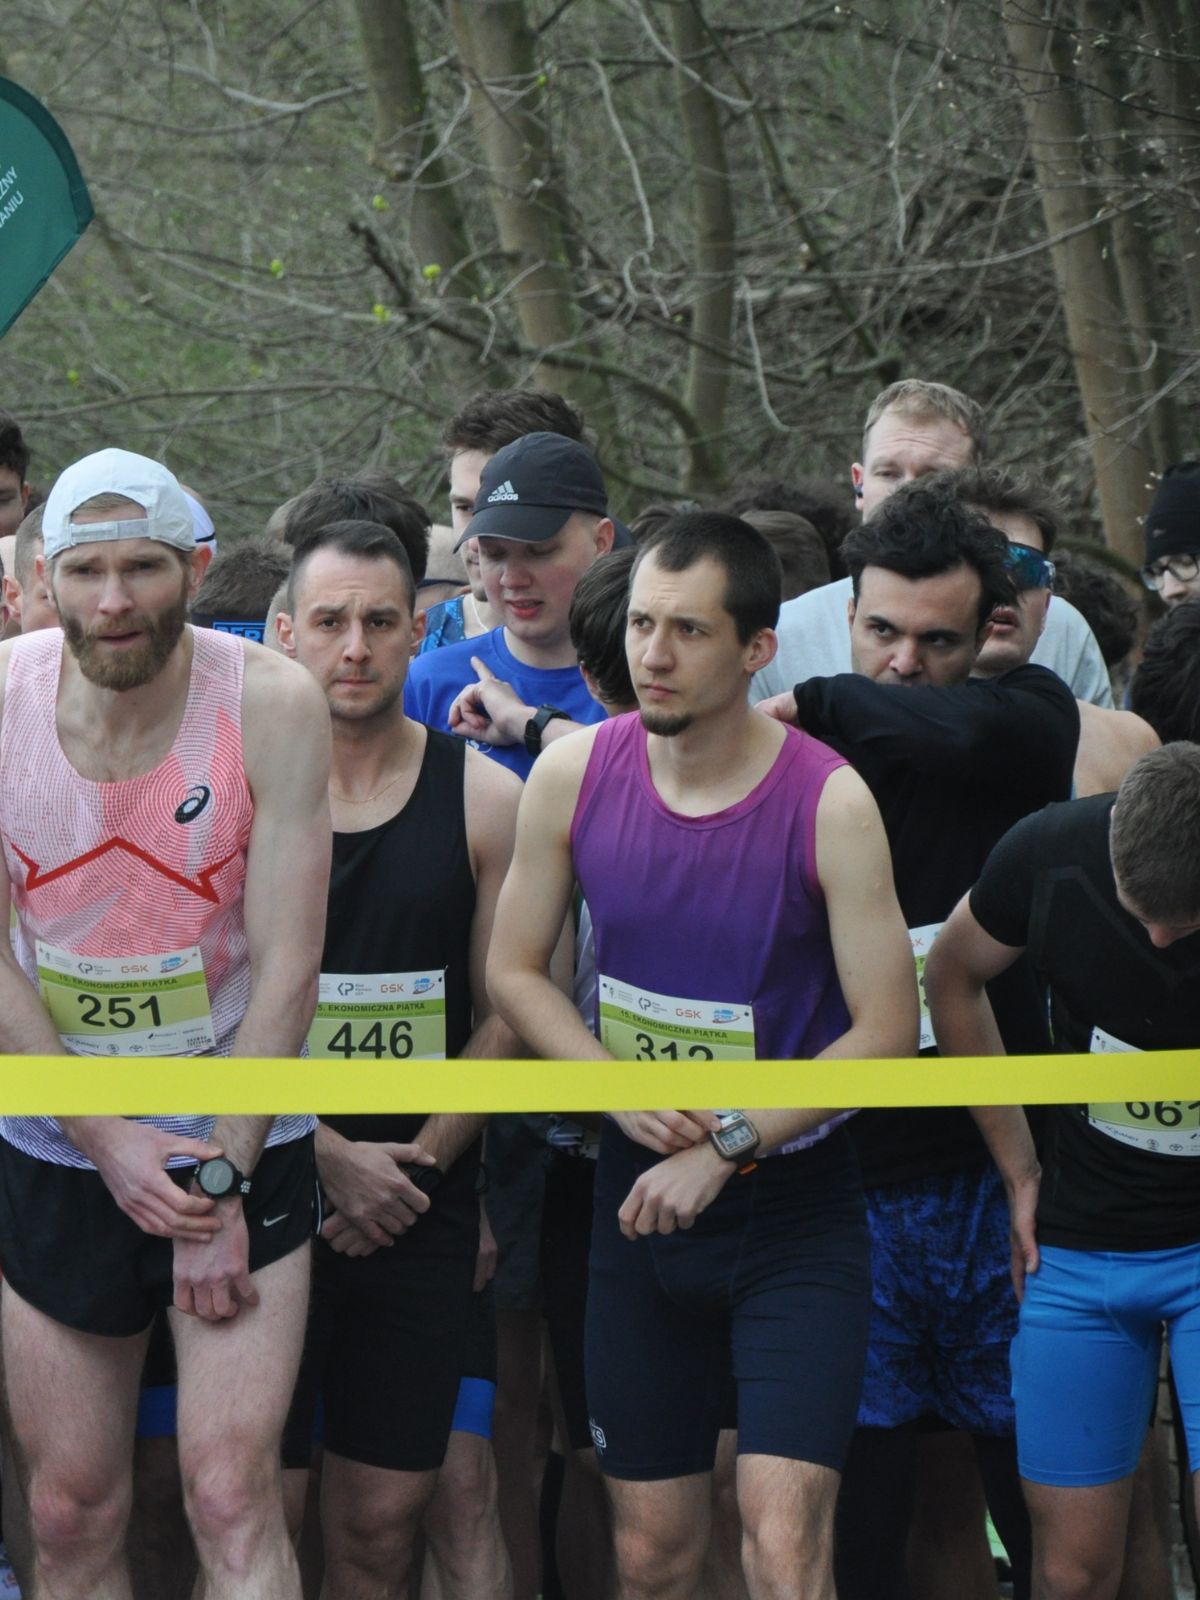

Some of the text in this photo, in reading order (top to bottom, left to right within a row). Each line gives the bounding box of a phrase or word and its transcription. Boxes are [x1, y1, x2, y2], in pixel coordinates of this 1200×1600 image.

[487, 492, 519, 503] adidas
[120, 964, 148, 974] GSK
[72, 978, 139, 989] EKONOMICZNA
[142, 978, 178, 989] PIĄTKA
[380, 983, 405, 994] GSK
[77, 993, 162, 1029] 251
[328, 1003, 394, 1012] EKONOMICZNA
[396, 1002, 425, 1012] PIĄTKA
[675, 1007, 702, 1019] GSK
[632, 1014, 691, 1035] EKONOMICZNA
[693, 1027, 728, 1039] PIĄTKA
[327, 1020, 414, 1059] 446
